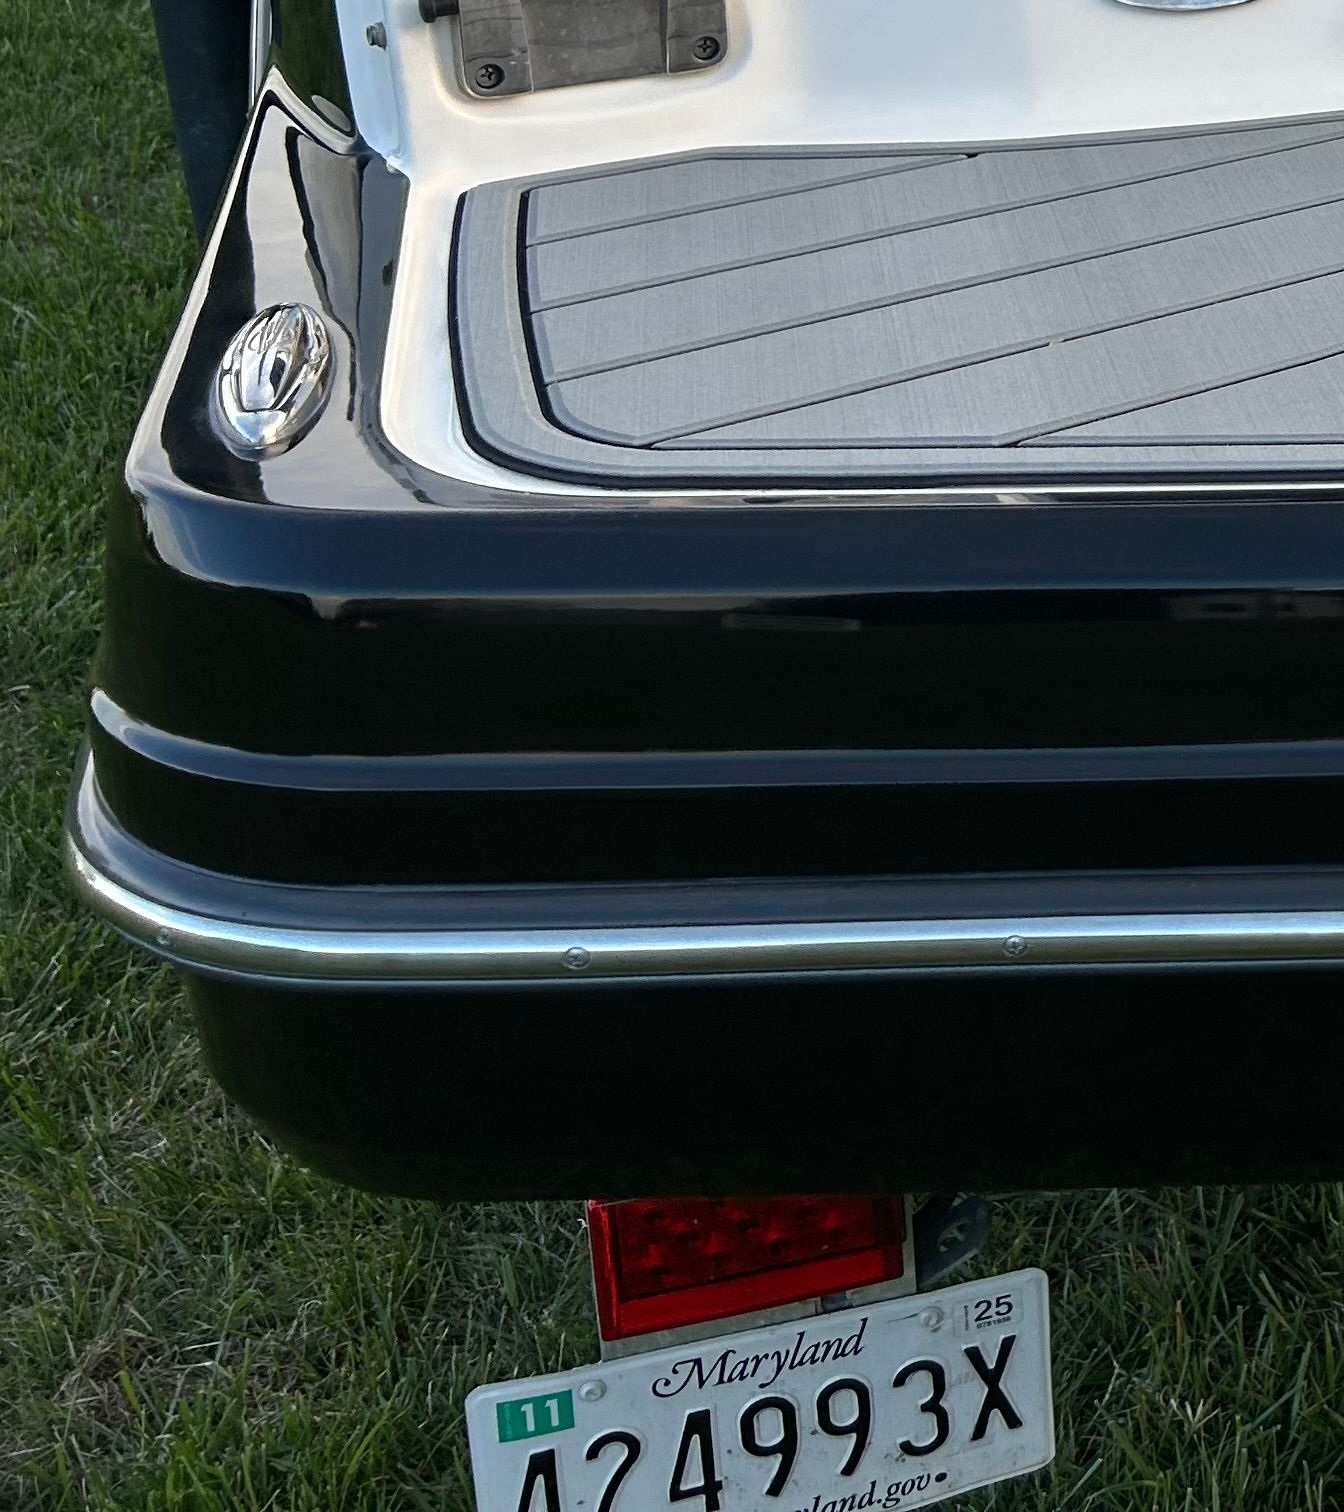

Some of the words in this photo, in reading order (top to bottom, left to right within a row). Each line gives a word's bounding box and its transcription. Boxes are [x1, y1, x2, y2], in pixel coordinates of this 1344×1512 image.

[974, 1293, 1014, 1323] 25
[651, 1318, 868, 1399] Maryland
[520, 1397, 560, 1433] 11
